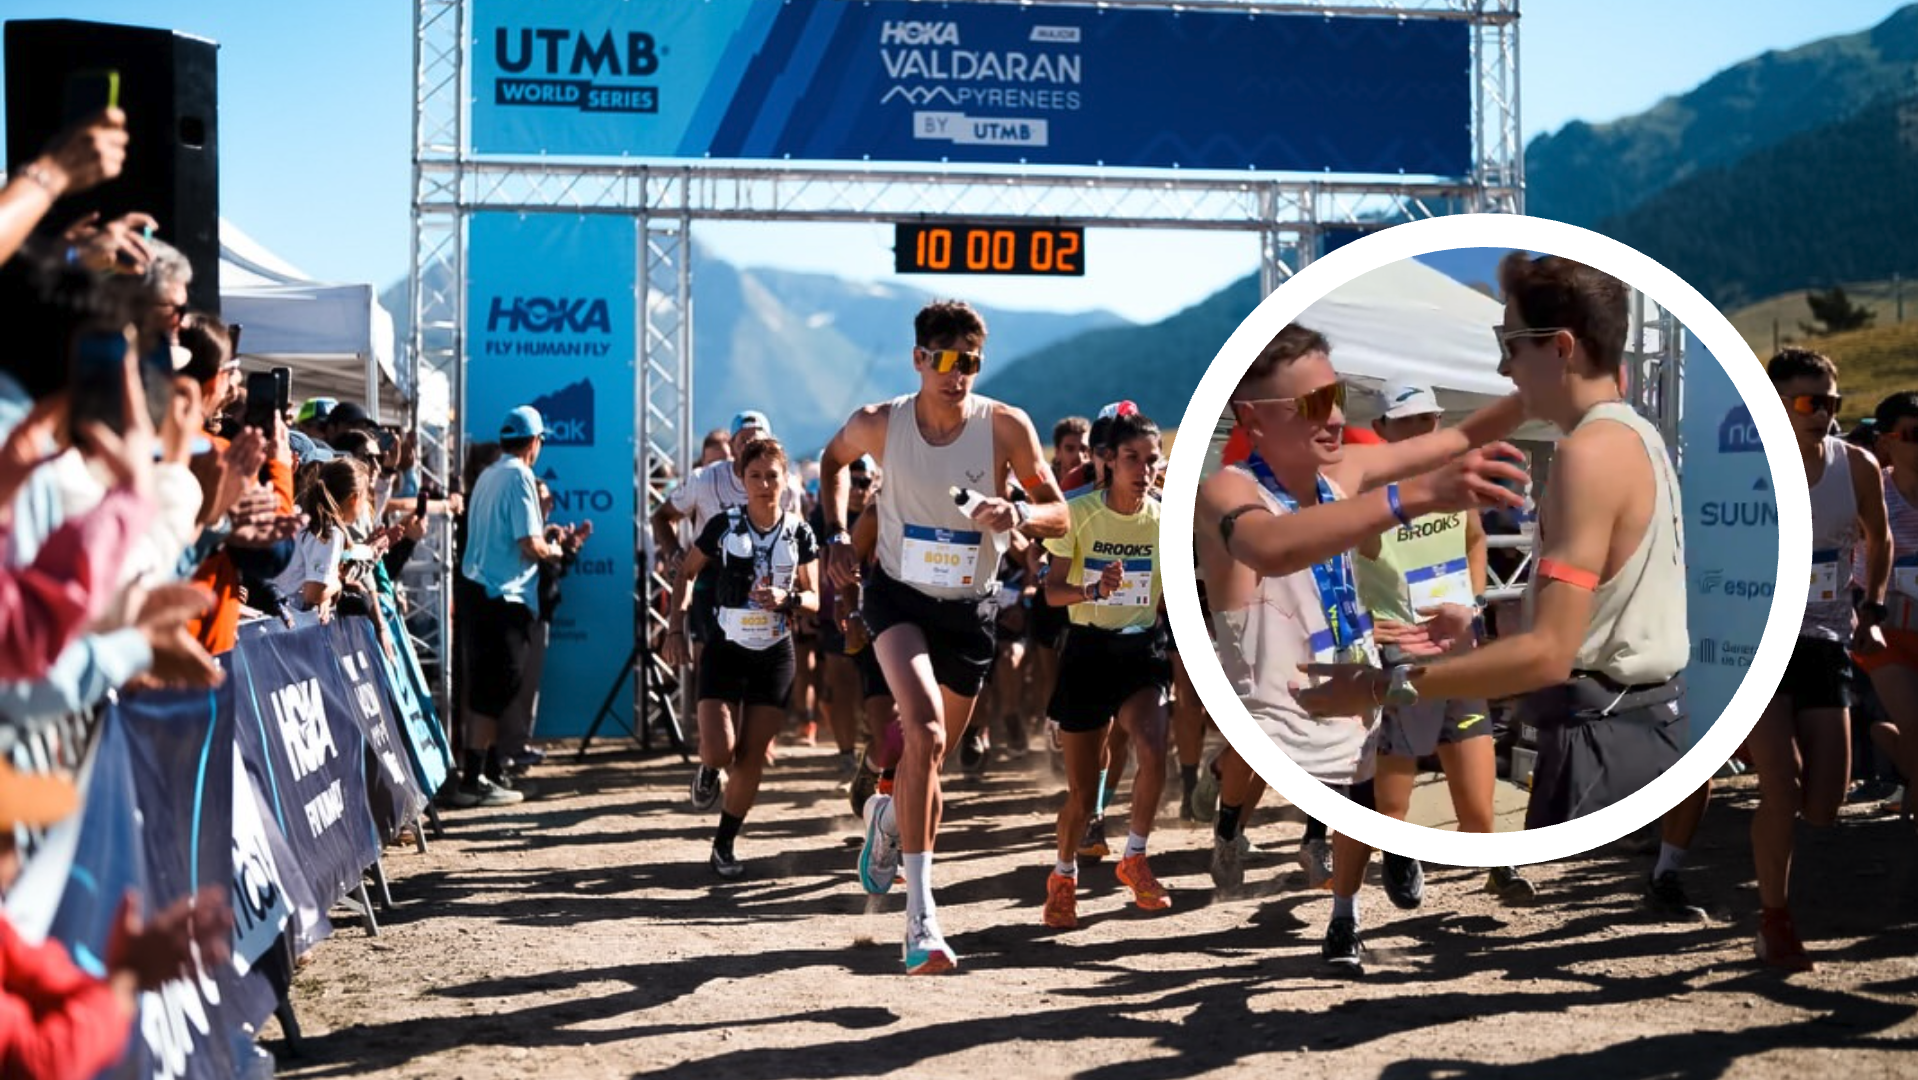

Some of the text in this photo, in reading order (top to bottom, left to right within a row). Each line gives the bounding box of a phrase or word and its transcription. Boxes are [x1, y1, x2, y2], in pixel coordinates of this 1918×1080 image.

[880, 21, 960, 46] HOKA
[1037, 28, 1076, 40] MAJOR
[495, 27, 659, 77] UTMB
[502, 82, 653, 109] WORLD SERIES
[957, 86, 1080, 110] PYRENEES
[924, 116, 1031, 141] BY UTMB
[916, 229, 1079, 271] 10 00 02
[486, 296, 612, 334] HOKA
[486, 341, 611, 357] FLY HUMAN FLY
[1397, 511, 1460, 541] BROOKS
[1093, 540, 1153, 556] BROOKS
